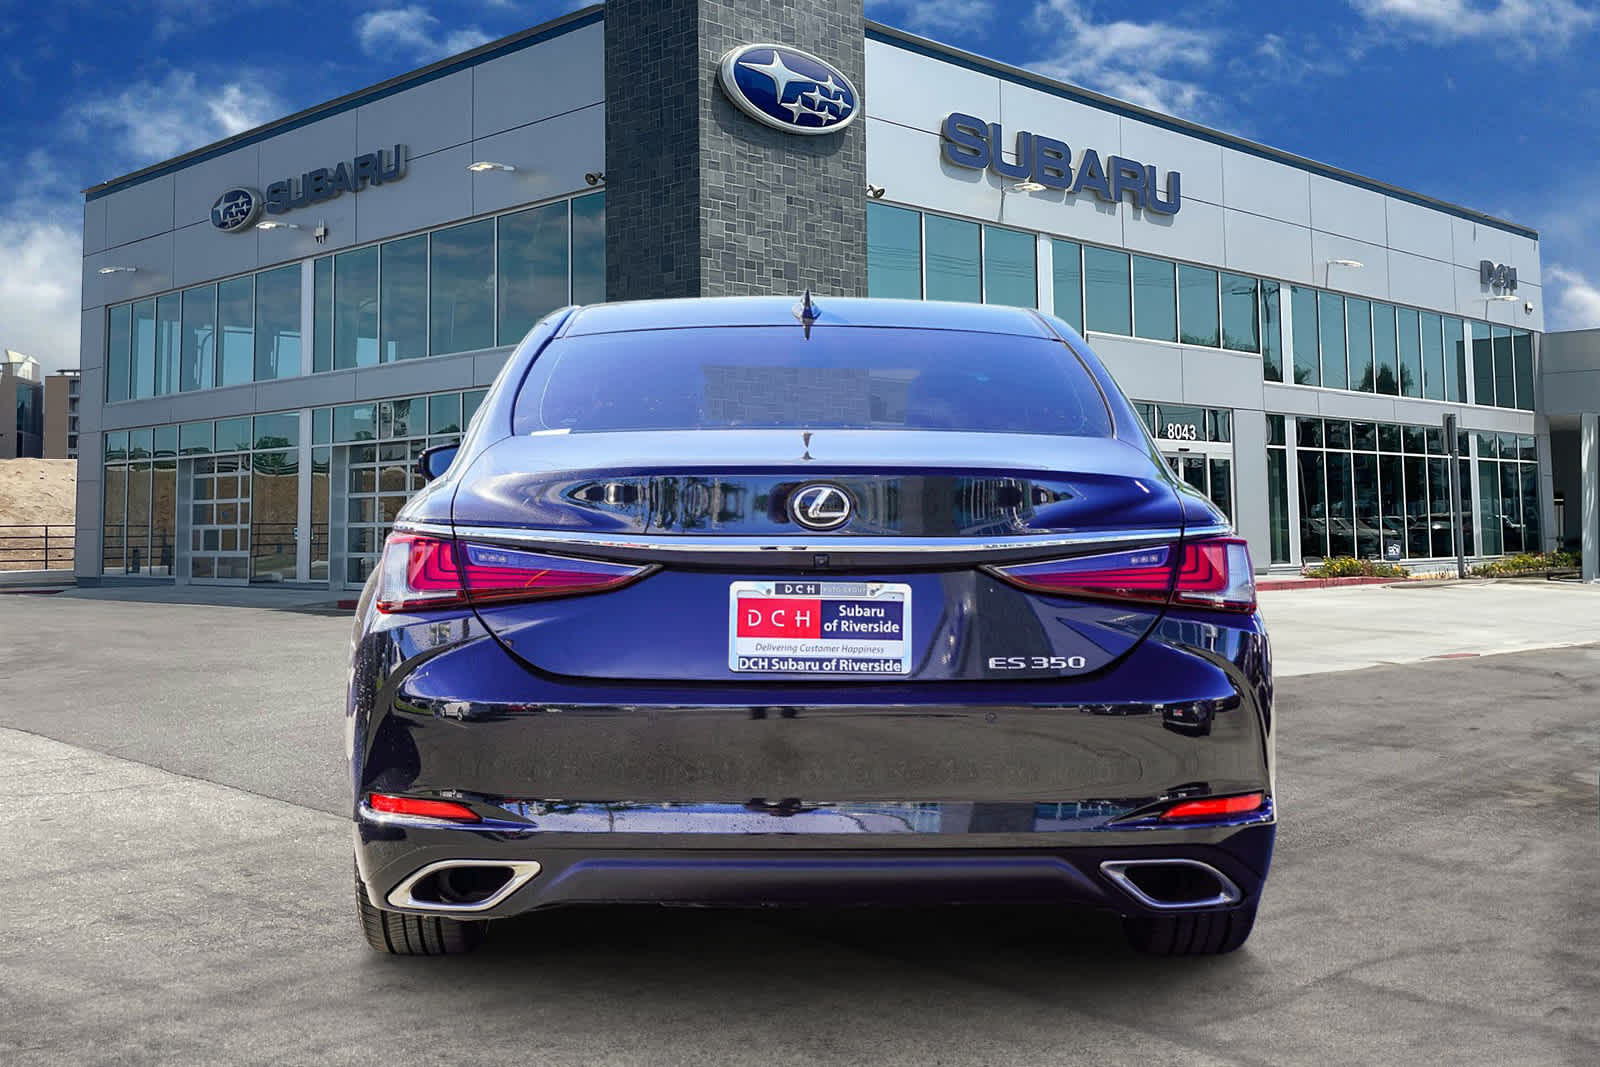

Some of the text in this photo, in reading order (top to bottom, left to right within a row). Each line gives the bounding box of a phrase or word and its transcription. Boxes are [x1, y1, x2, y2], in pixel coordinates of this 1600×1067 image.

[942, 112, 1180, 215] SUBARU
[266, 144, 406, 214] SUBARU
[1167, 423, 1196, 440] 8043
[784, 584, 815, 594] DCH
[838, 604, 885, 617] Subaru
[747, 609, 810, 627] DCH
[823, 620, 900, 633] of Riverside
[755, 643, 884, 655] Delivering Customer Happiness
[739, 658, 902, 671] DCH Subaru of Riverside
[988, 655, 1086, 669] ES 350
